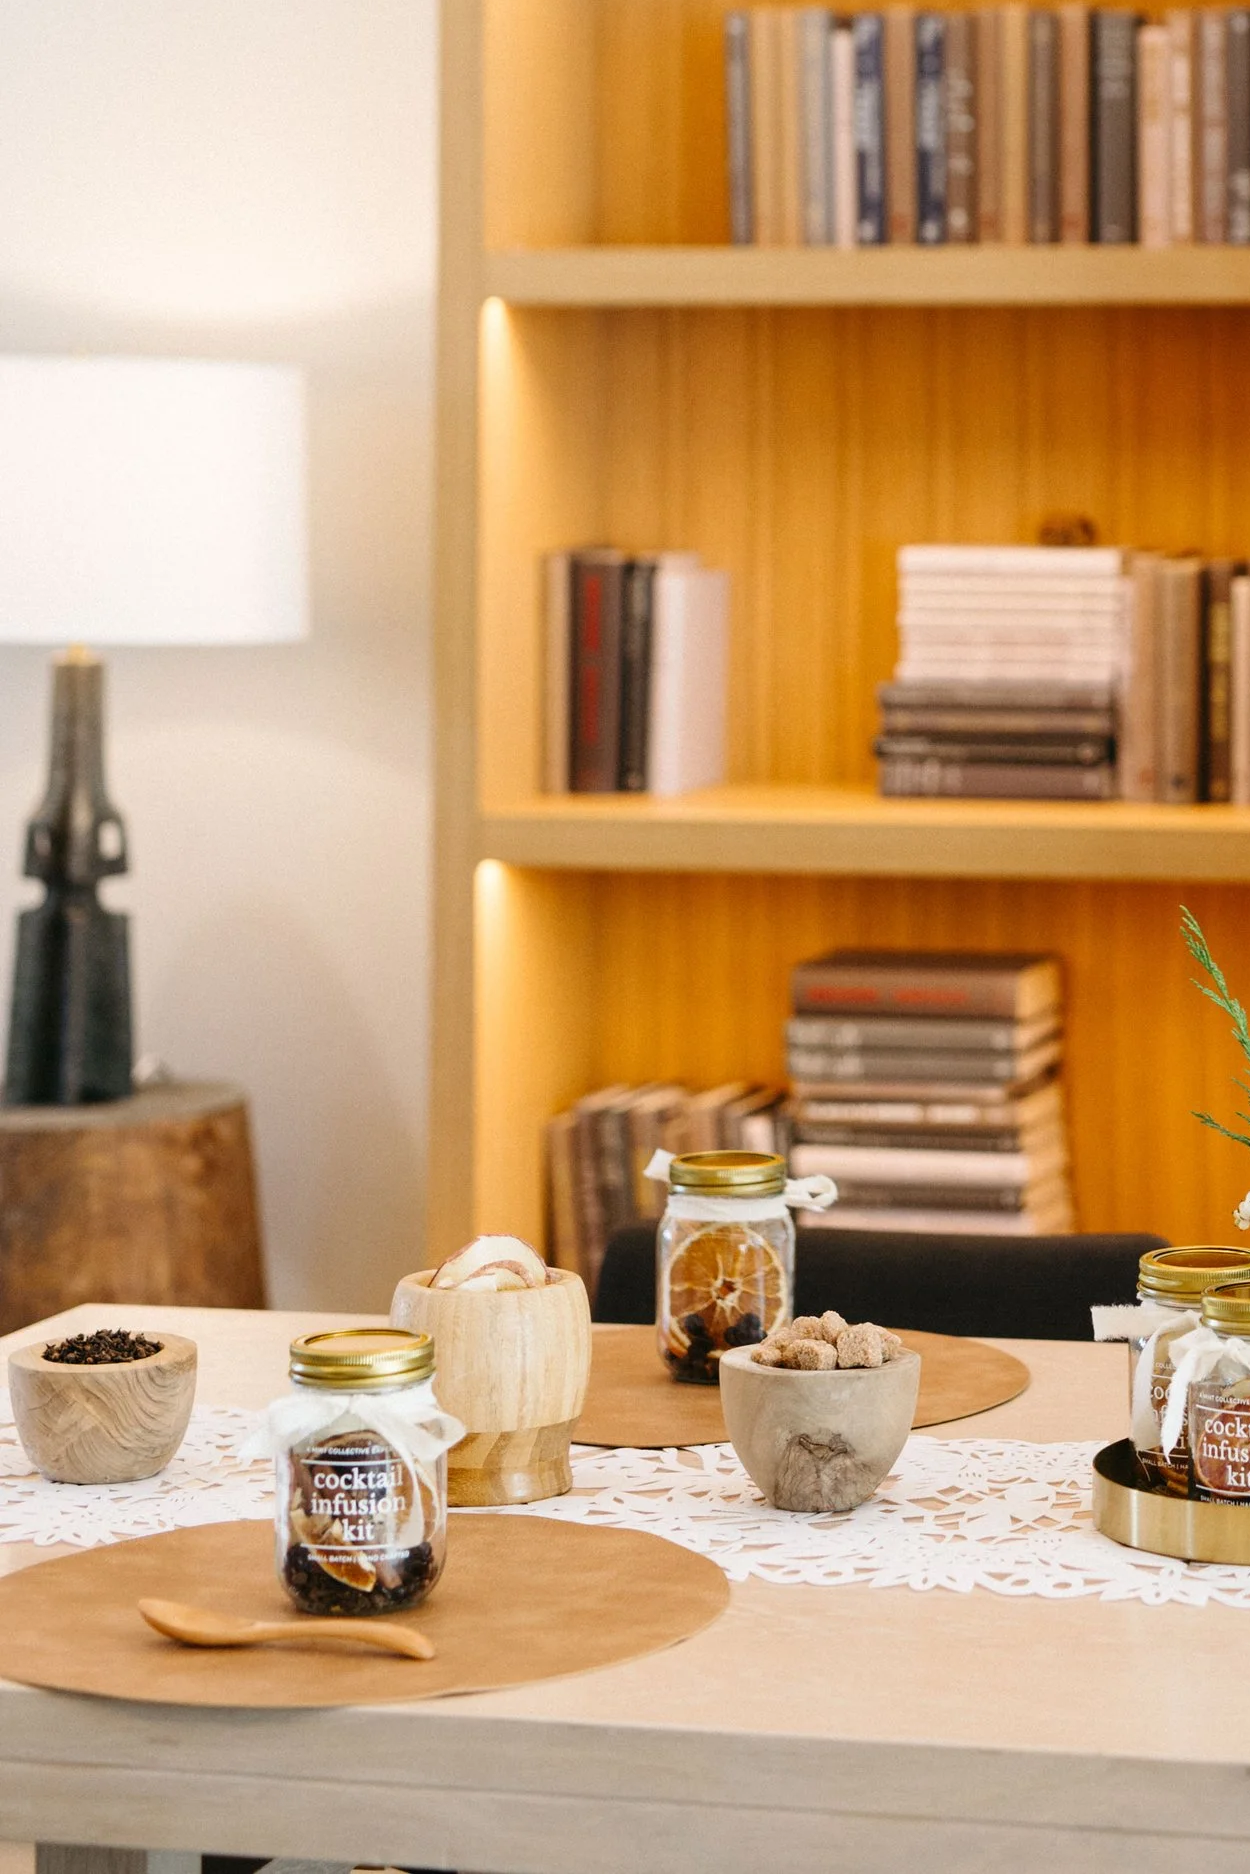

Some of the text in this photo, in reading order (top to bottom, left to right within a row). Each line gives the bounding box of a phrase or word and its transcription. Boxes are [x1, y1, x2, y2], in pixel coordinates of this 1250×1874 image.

[1215, 1395, 1250, 1406] COLLECTIVE
[327, 1446, 370, 1457] COLLECTIVE
[313, 1465, 403, 1490] cocktail
[311, 1492, 406, 1516] infusion
[342, 1518, 375, 1542] kit
